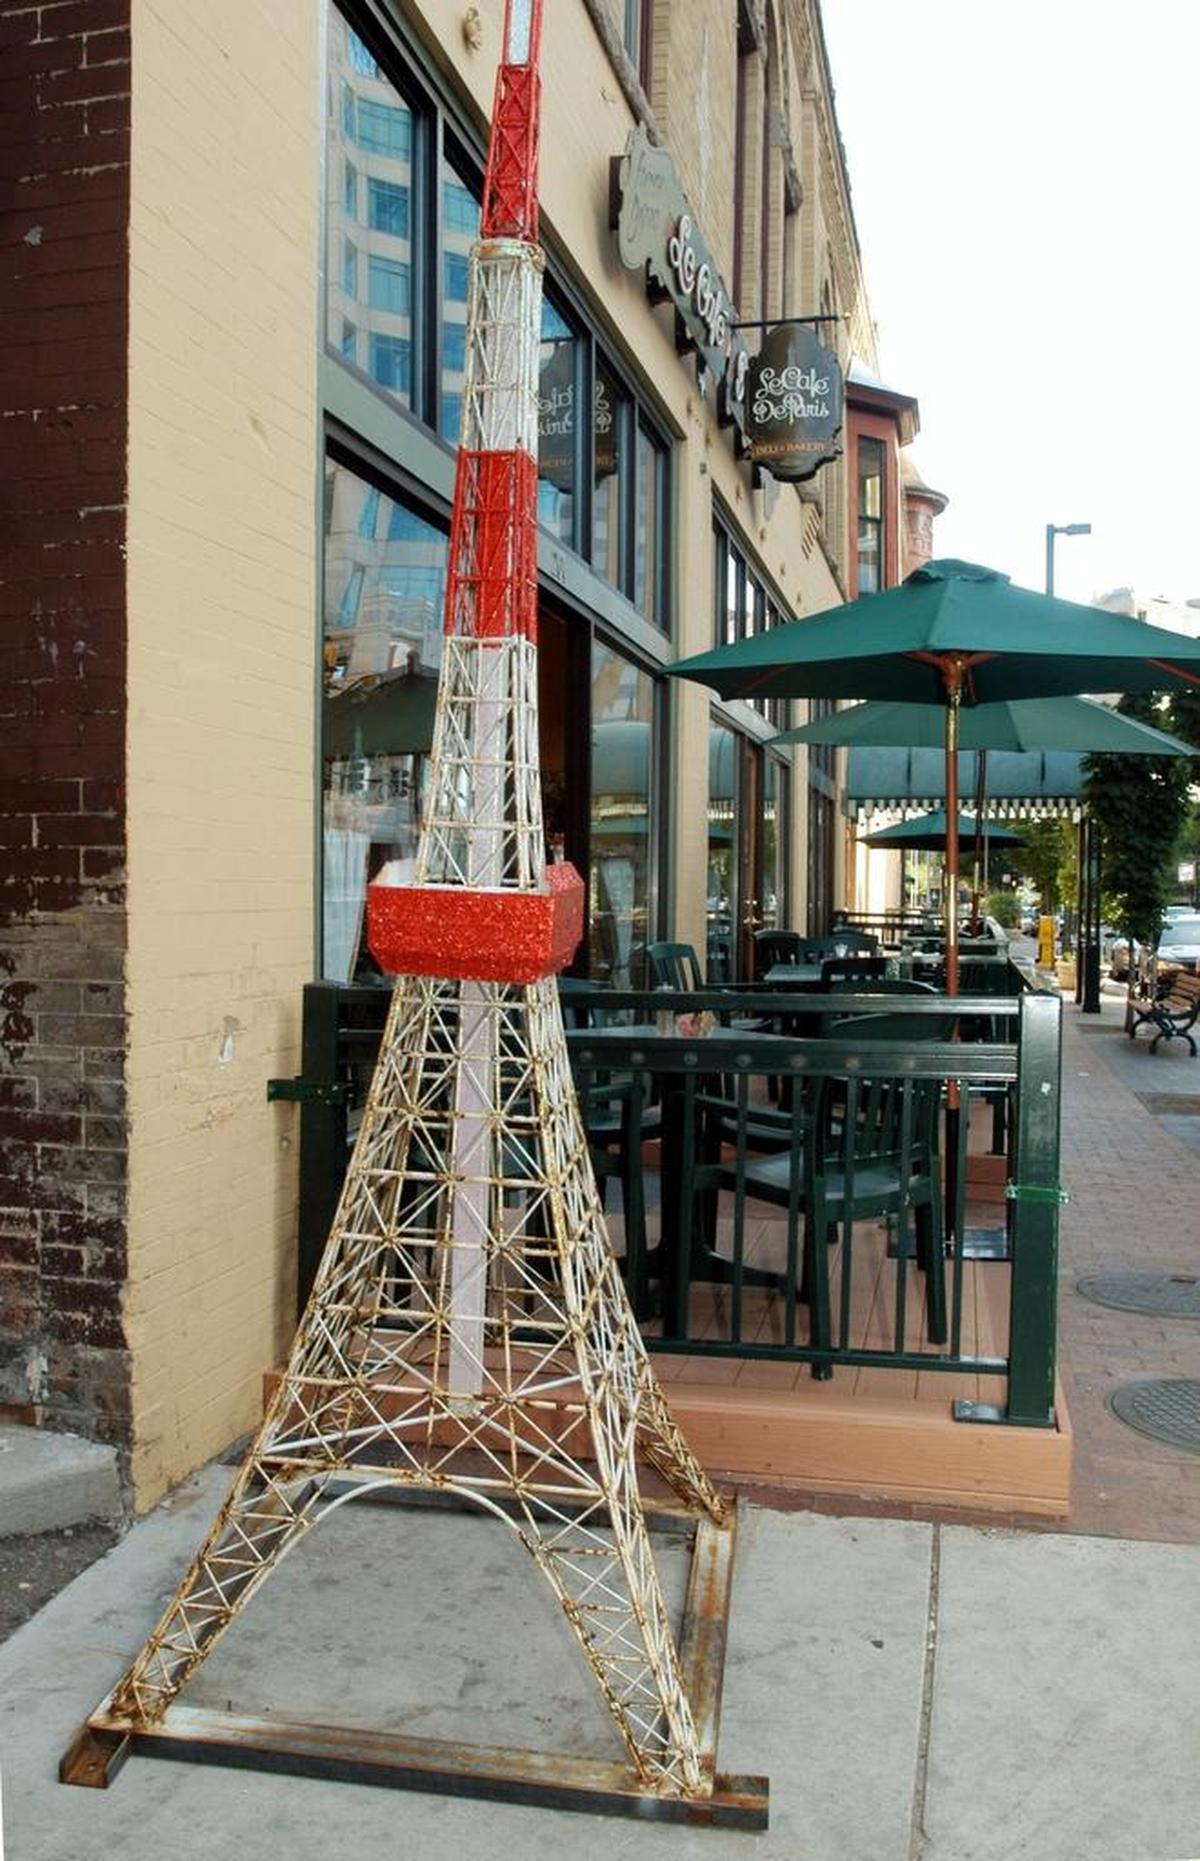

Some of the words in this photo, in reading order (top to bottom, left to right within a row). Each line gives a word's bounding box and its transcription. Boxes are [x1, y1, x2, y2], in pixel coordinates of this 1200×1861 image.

[755, 367, 784, 400] Le
[752, 399, 787, 424] De
[783, 392, 830, 425] Paris
[786, 442, 825, 452] BAKERY
